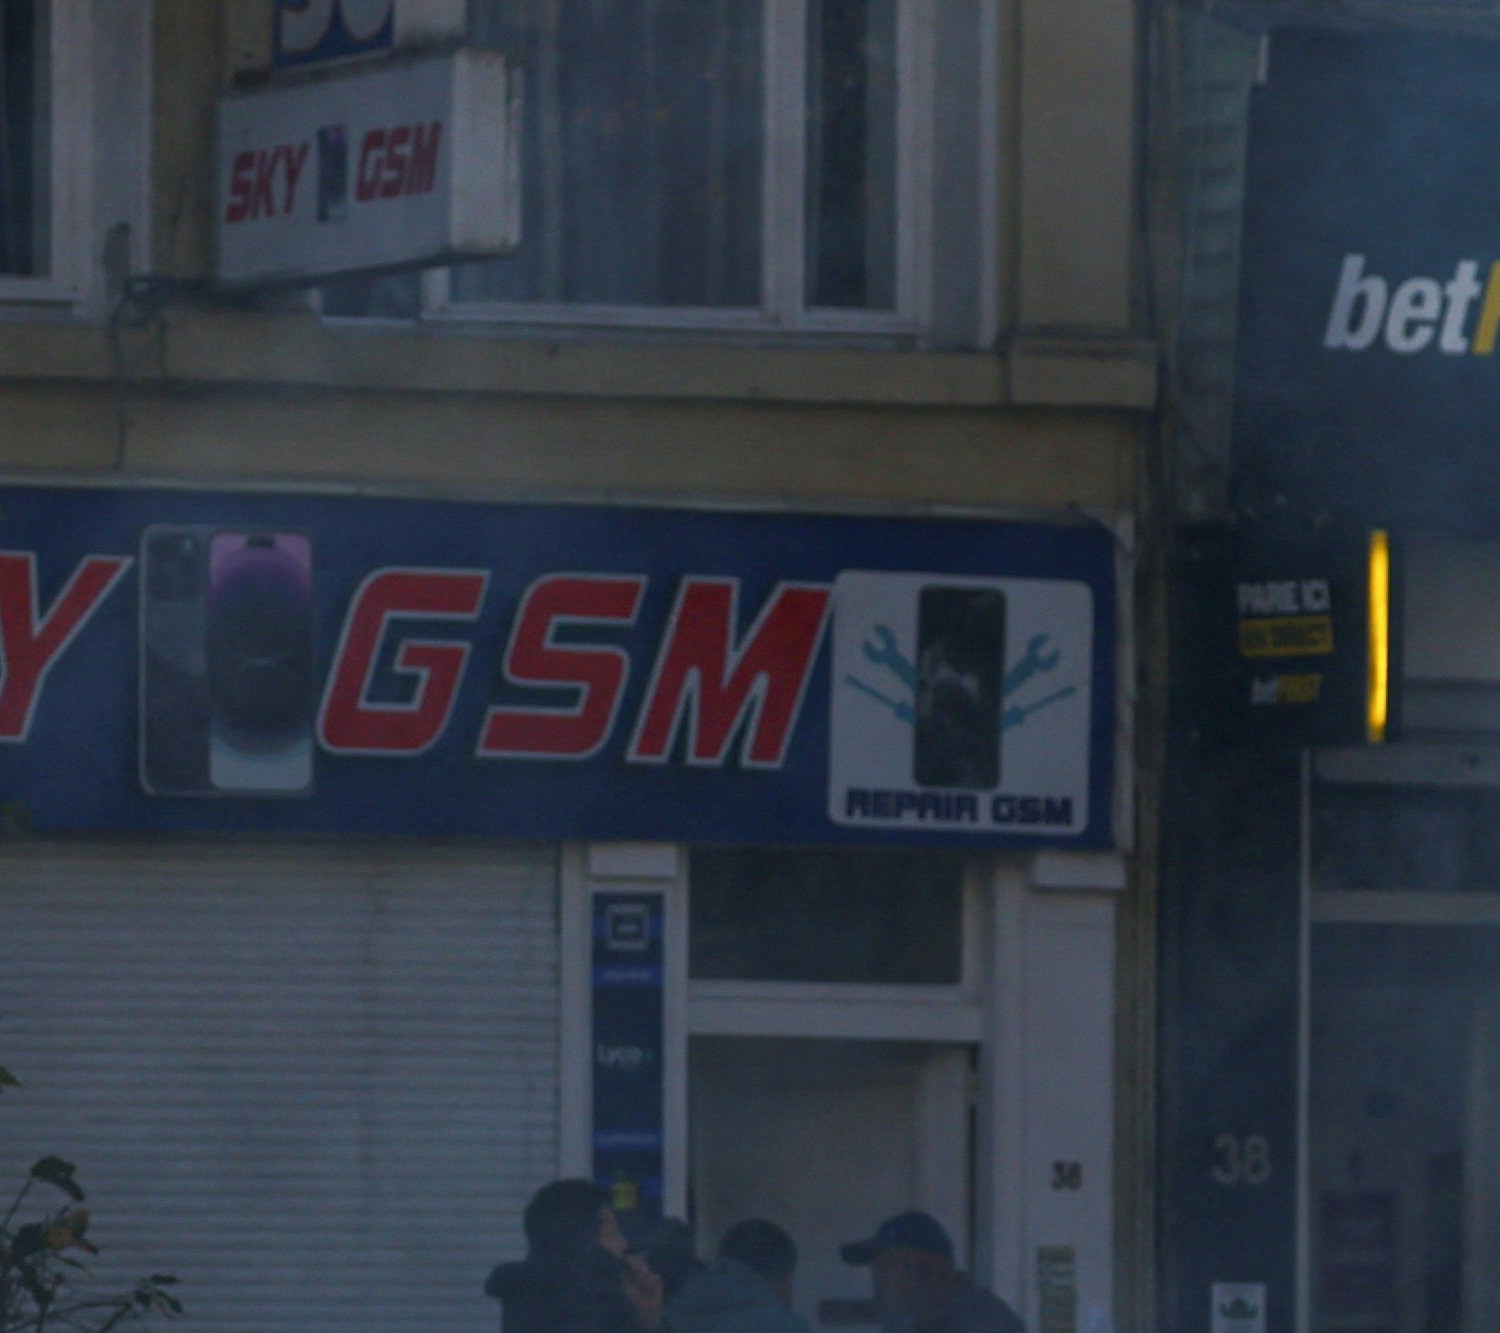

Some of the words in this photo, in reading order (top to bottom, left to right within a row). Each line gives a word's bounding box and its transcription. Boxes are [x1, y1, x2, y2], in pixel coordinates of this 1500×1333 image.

[226, 142, 310, 223] SKY
[354, 119, 444, 203] GSM
[316, 566, 834, 770] GSM
[848, 788, 979, 822] REPAIR
[991, 794, 1073, 825] GSM
[1211, 1132, 1273, 1187] 38
